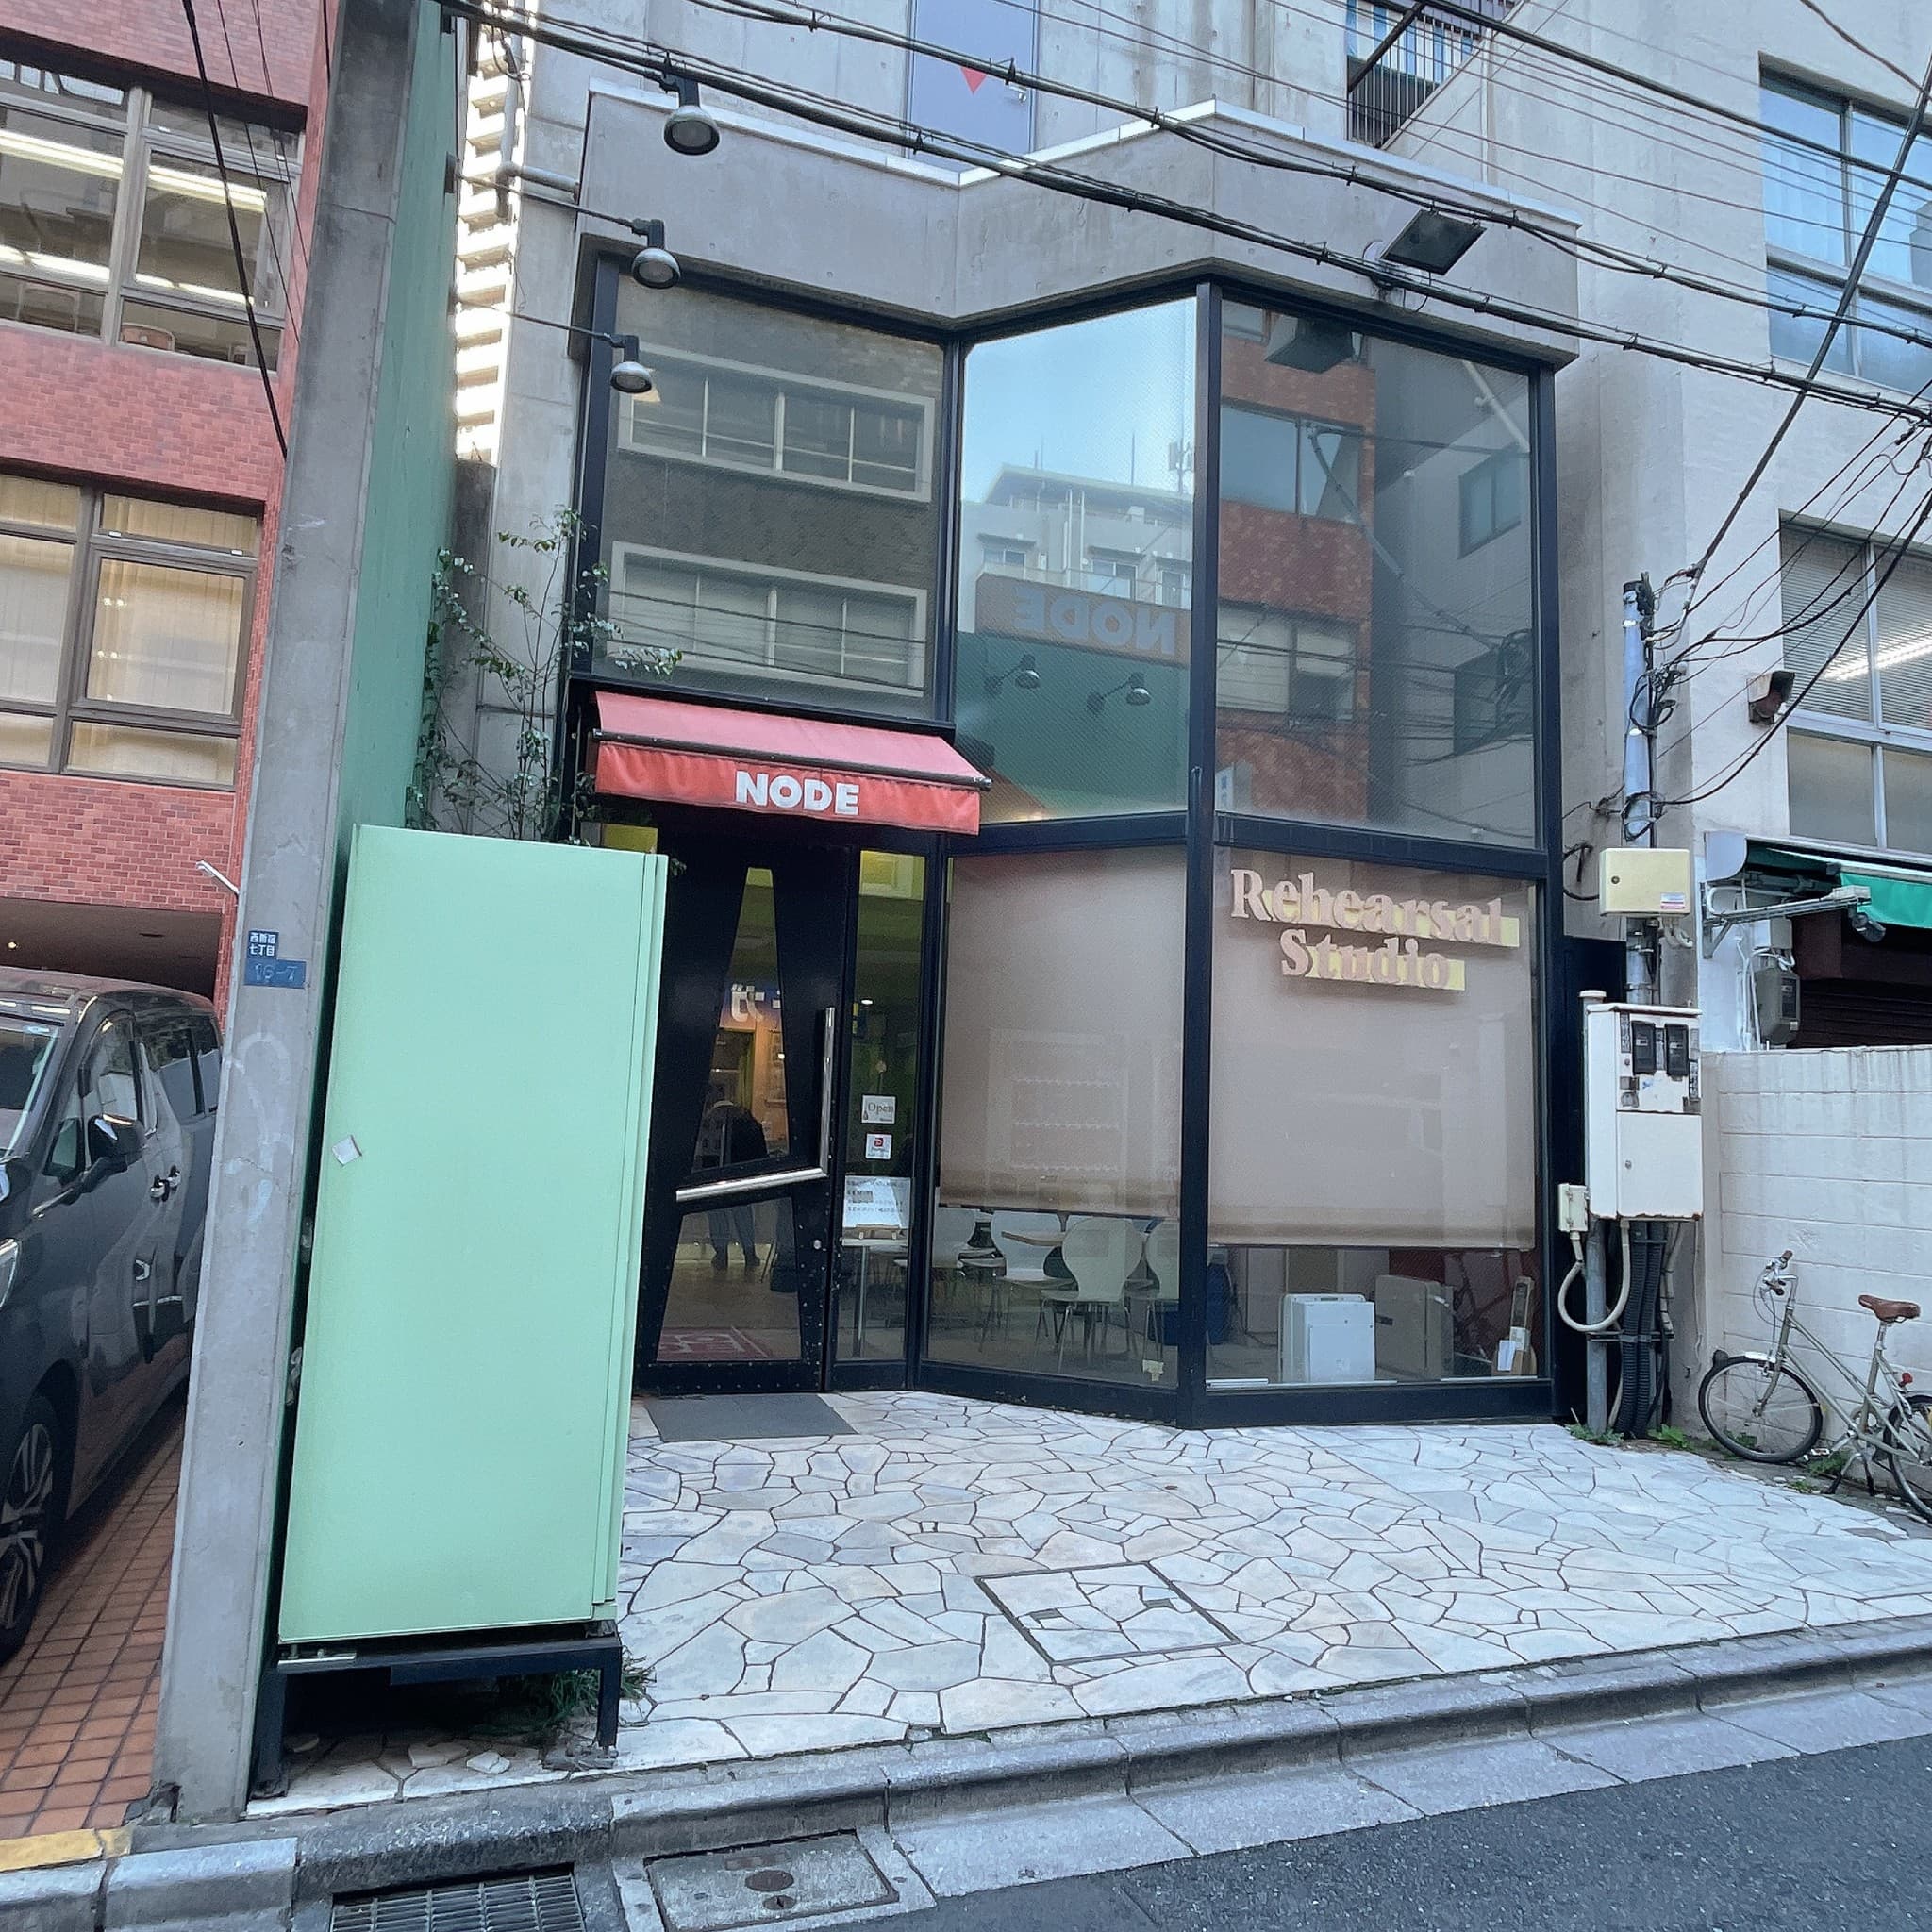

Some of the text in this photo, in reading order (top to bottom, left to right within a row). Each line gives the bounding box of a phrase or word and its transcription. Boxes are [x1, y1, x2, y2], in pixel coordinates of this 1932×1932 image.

[736, 770, 859, 816] NODE
[1230, 869, 1503, 944] Rehearsal
[249, 943, 275, 957] 七丁目
[1279, 928, 1450, 989] Studio
[867, 1101, 894, 1115] Open
